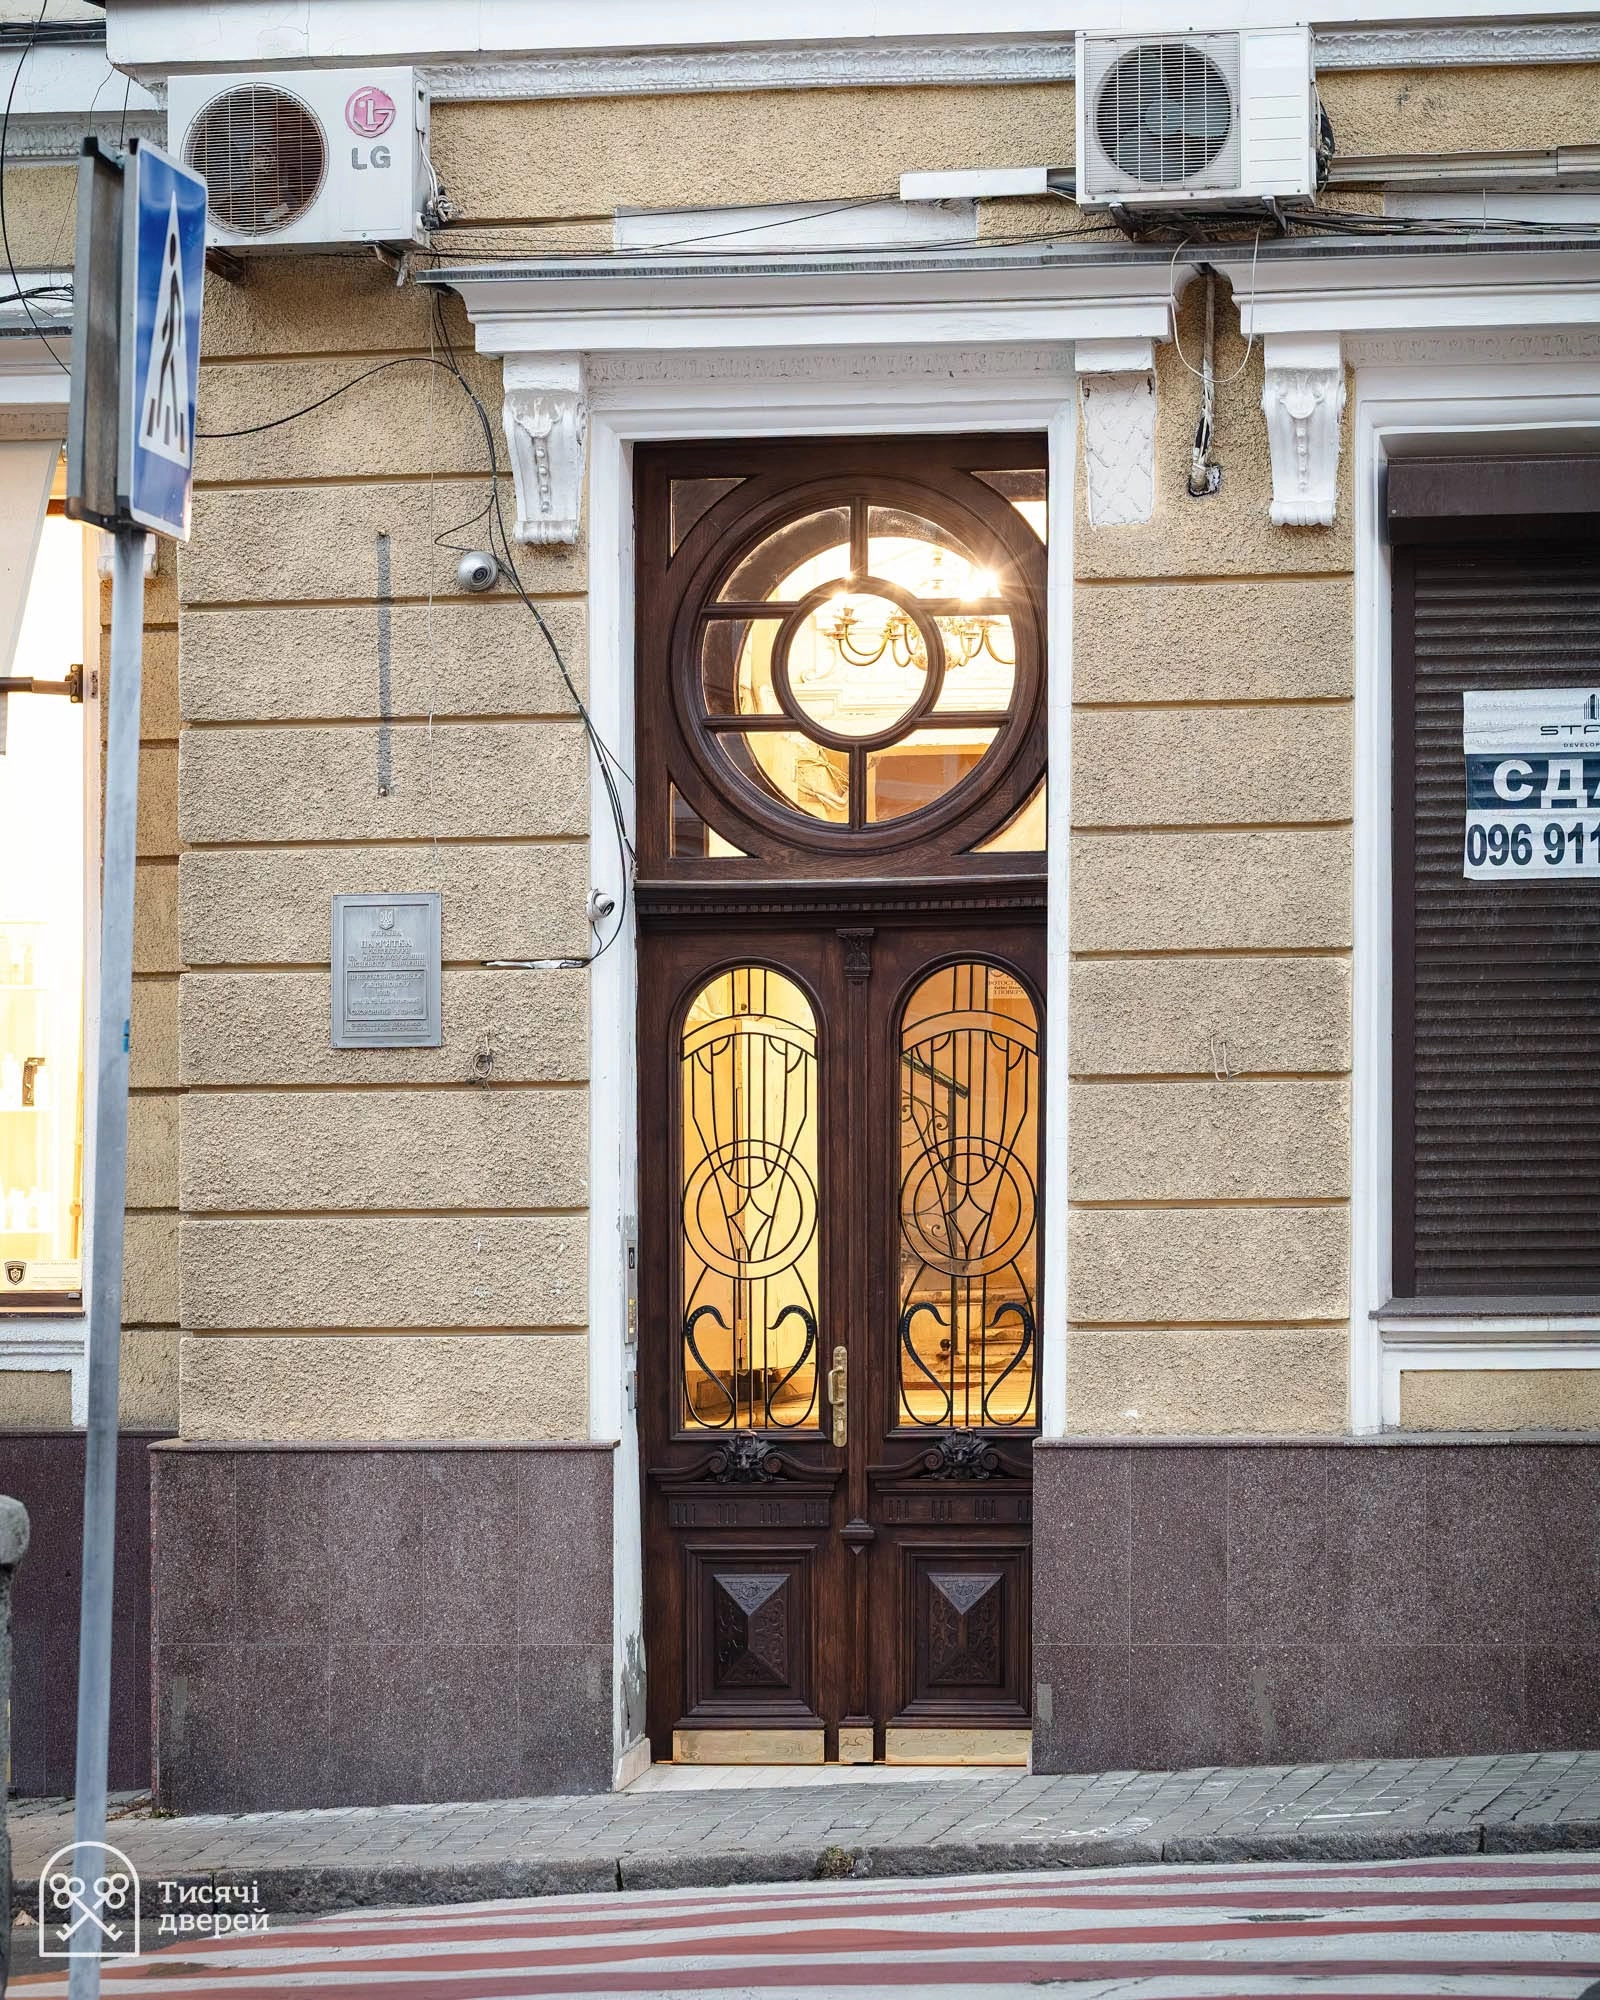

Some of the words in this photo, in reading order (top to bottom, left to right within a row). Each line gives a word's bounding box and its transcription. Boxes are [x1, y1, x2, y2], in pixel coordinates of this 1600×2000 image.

[351, 145, 391, 170] LG
[1493, 758, 1600, 808] СД
[1467, 823, 1533, 866] 096
